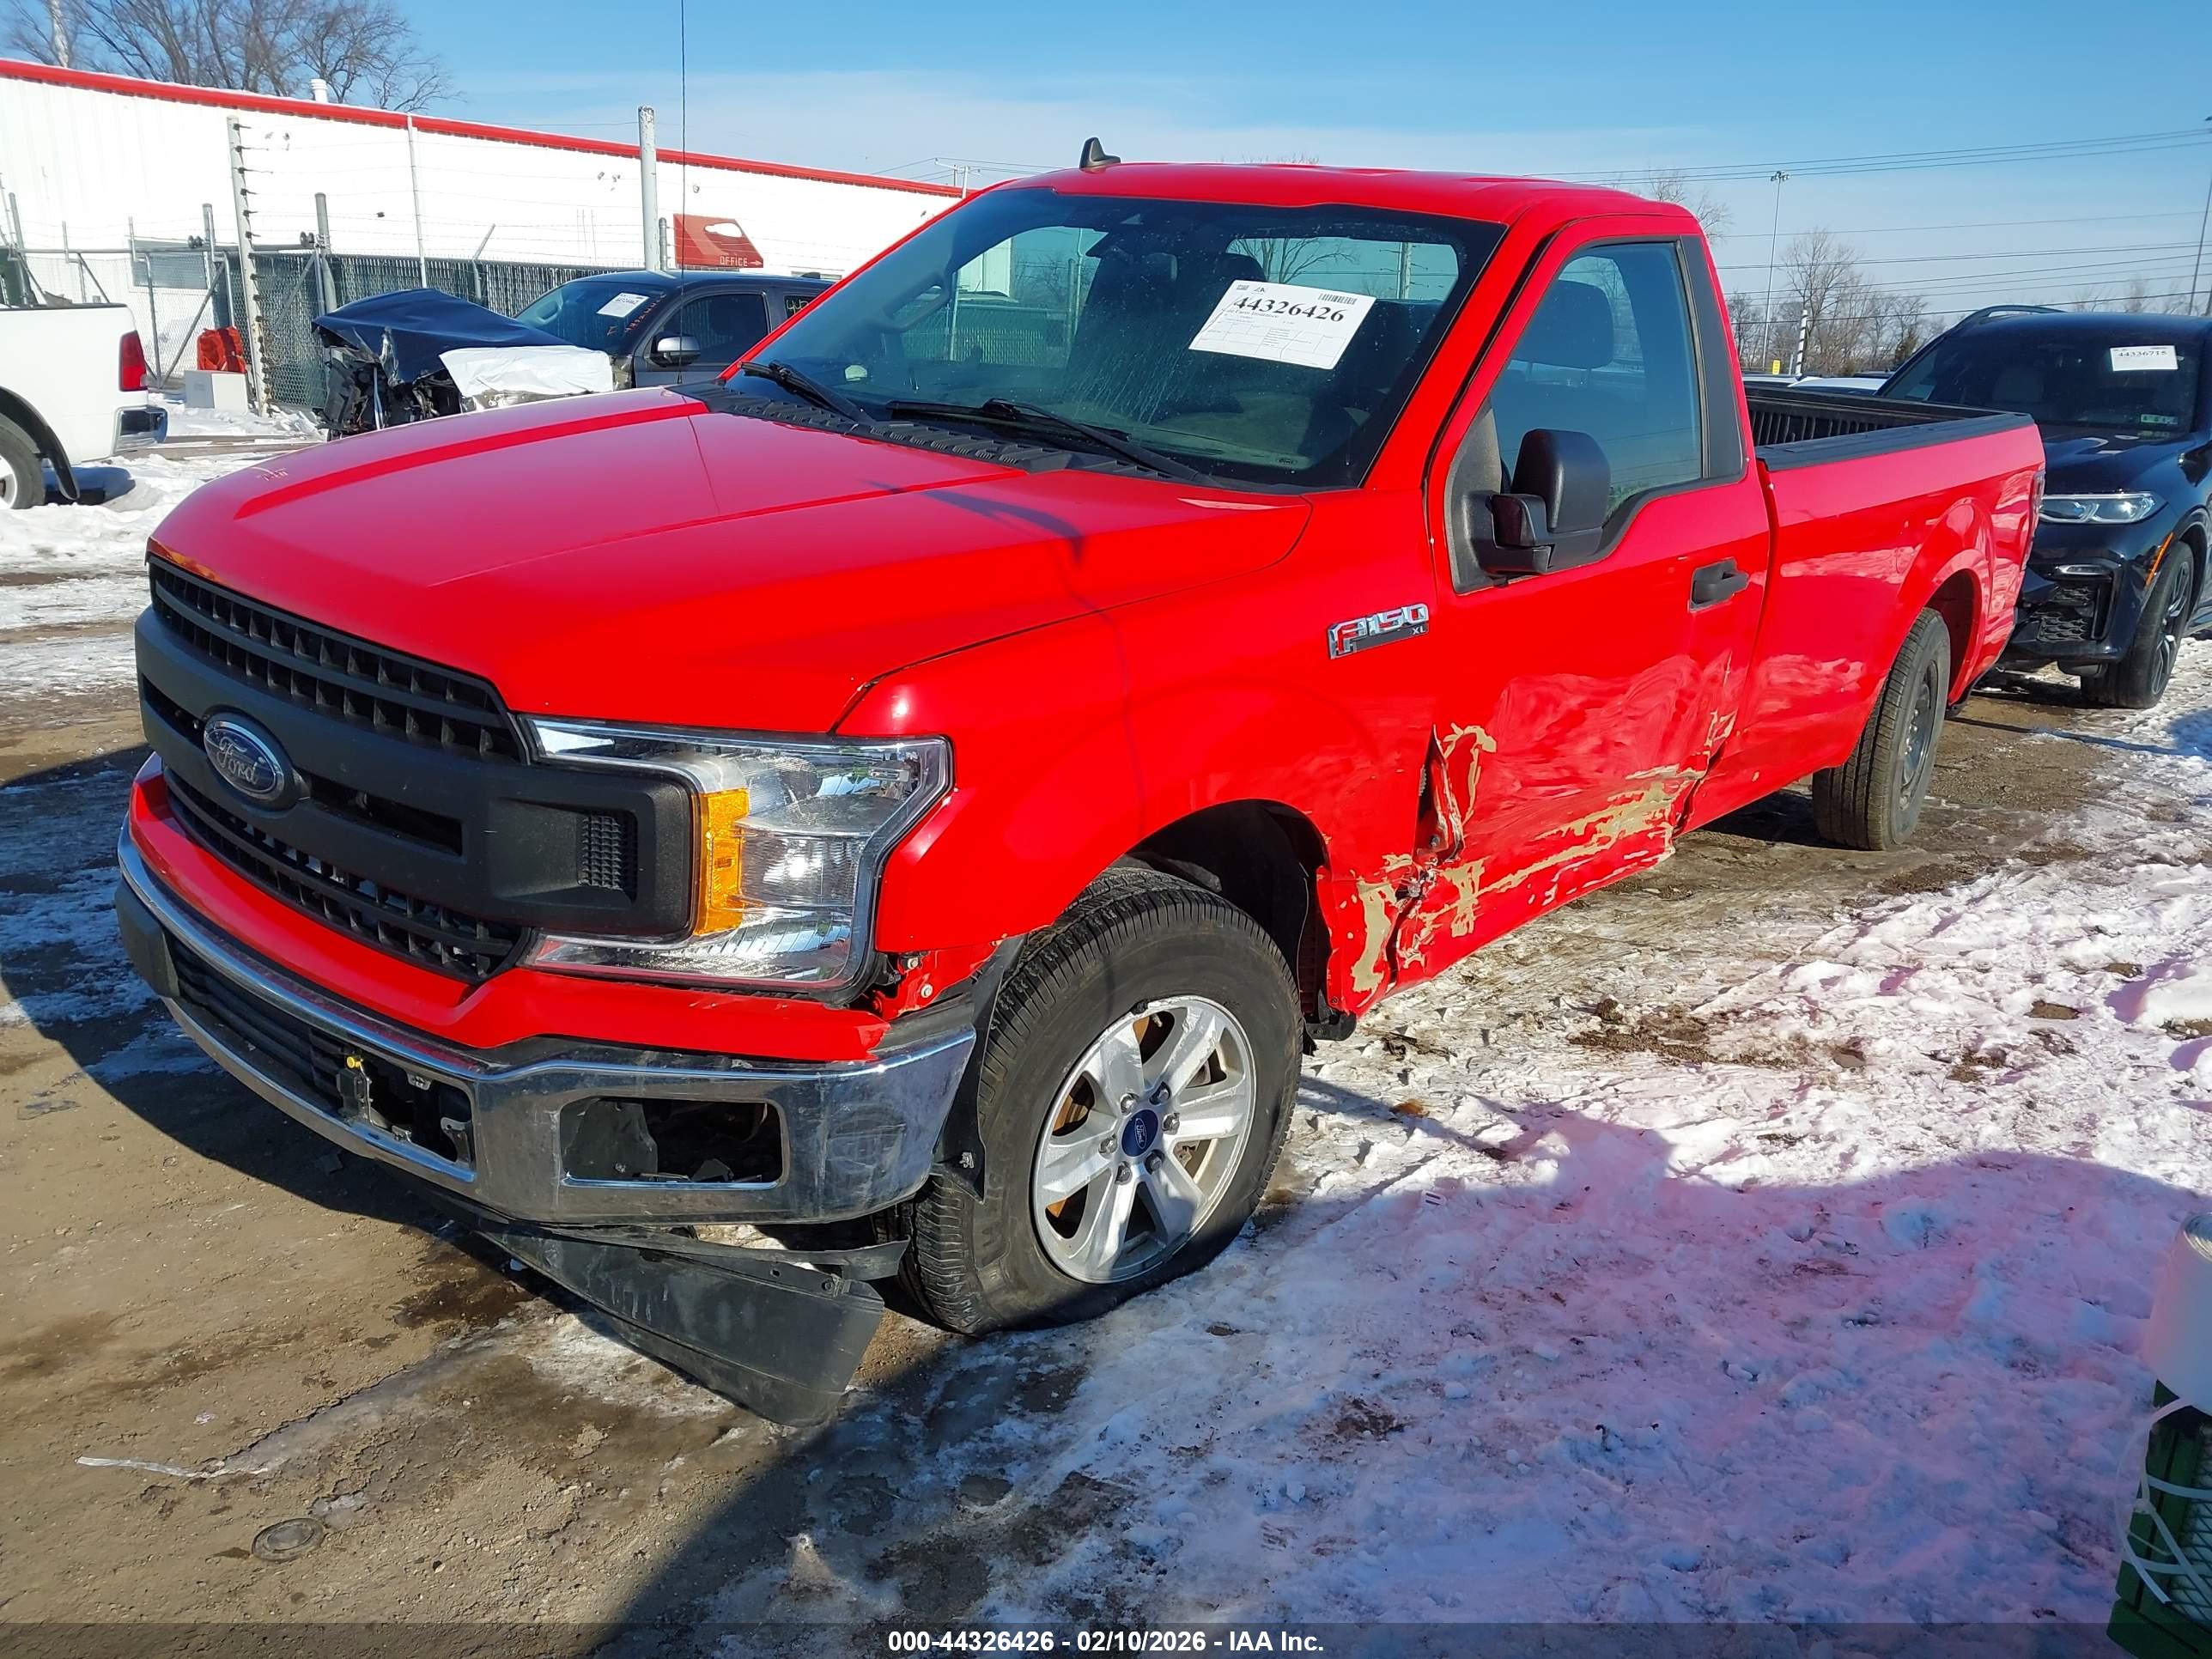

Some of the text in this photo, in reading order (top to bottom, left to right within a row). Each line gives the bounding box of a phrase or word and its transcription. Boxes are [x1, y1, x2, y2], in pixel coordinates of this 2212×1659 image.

[720, 255, 748, 267] OFFICE
[1233, 296, 1347, 322] 44326426
[1412, 626, 1426, 635] XL
[213, 736, 259, 785] Ford
